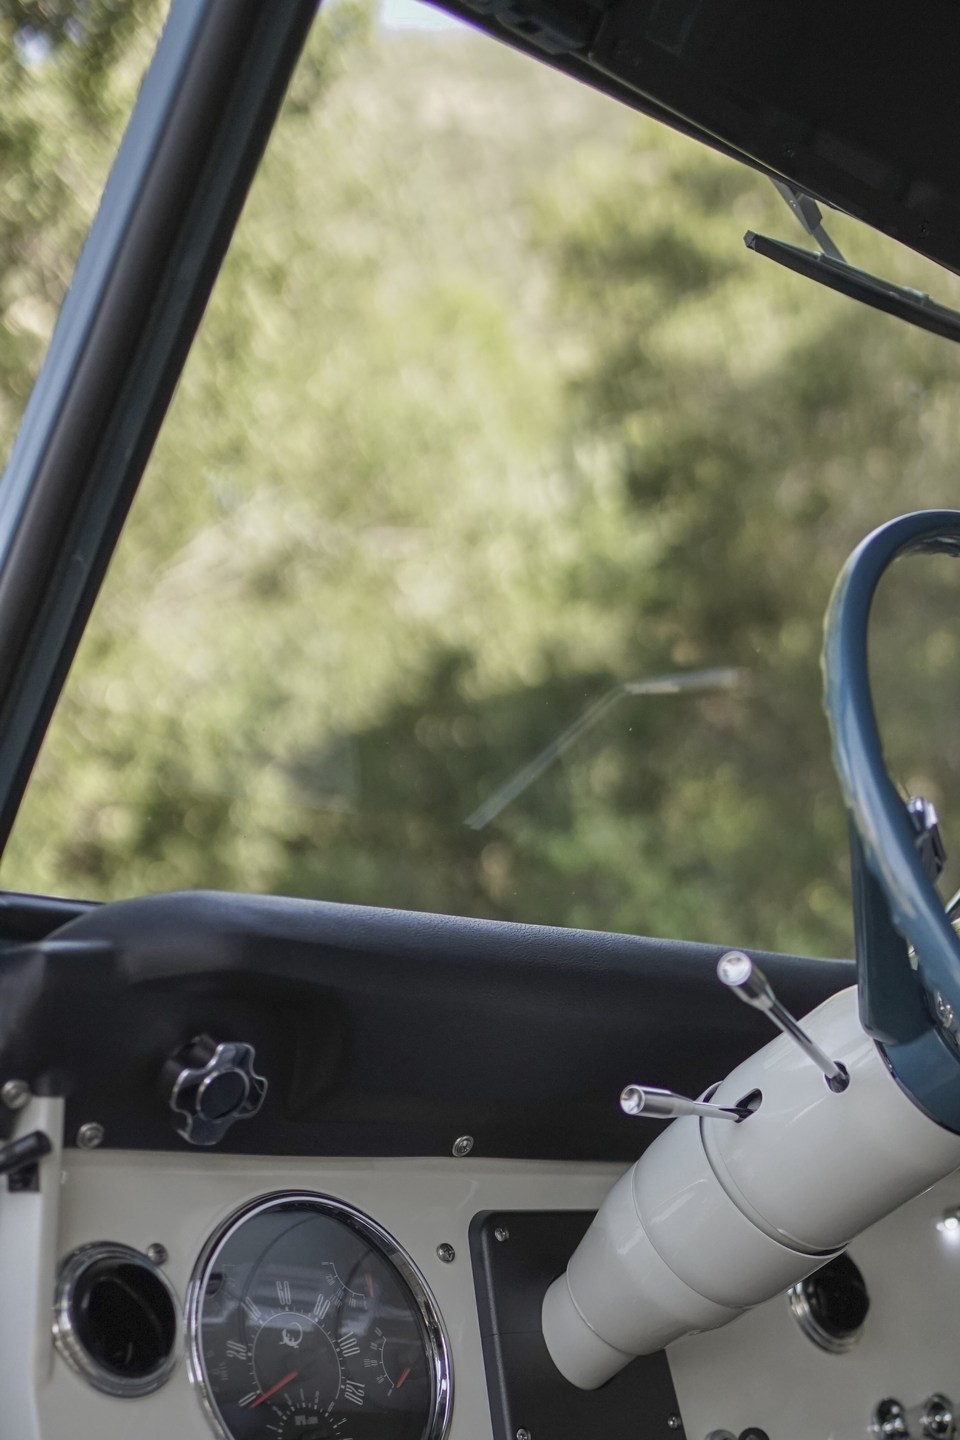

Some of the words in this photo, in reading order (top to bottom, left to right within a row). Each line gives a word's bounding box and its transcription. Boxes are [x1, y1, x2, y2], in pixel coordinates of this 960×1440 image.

[275, 1281, 291, 1305] 60
[313, 1294, 331, 1319] 80
[226, 1340, 247, 1360] 20
[338, 1331, 360, 1357] 100
[345, 1380, 365, 1406] 120
